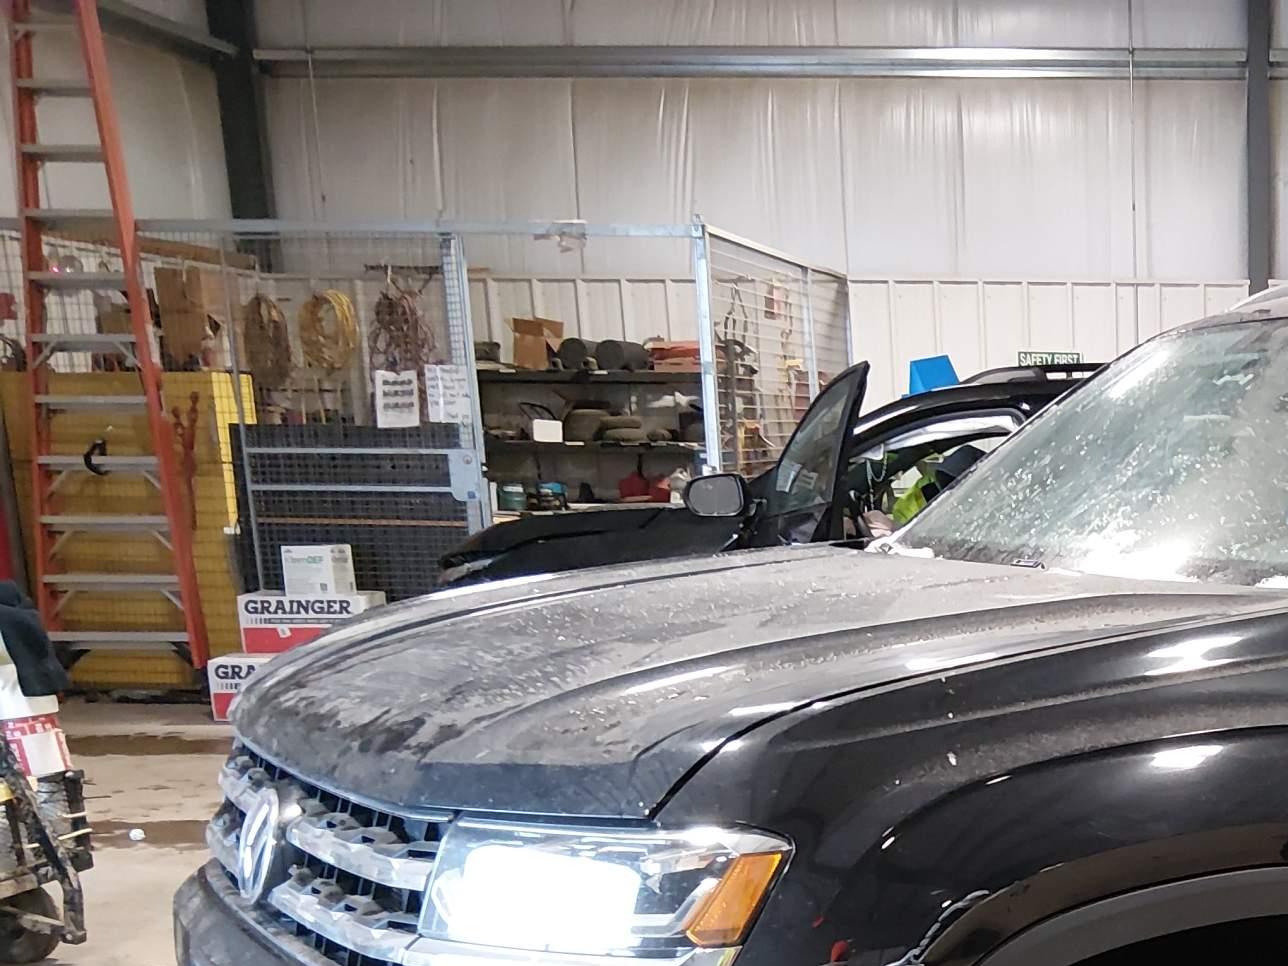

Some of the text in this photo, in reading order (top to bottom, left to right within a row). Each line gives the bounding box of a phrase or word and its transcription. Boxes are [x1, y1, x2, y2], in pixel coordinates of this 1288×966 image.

[1019, 352, 1079, 367] SAFETY FIRST
[244, 599, 352, 615] GRAINGER
